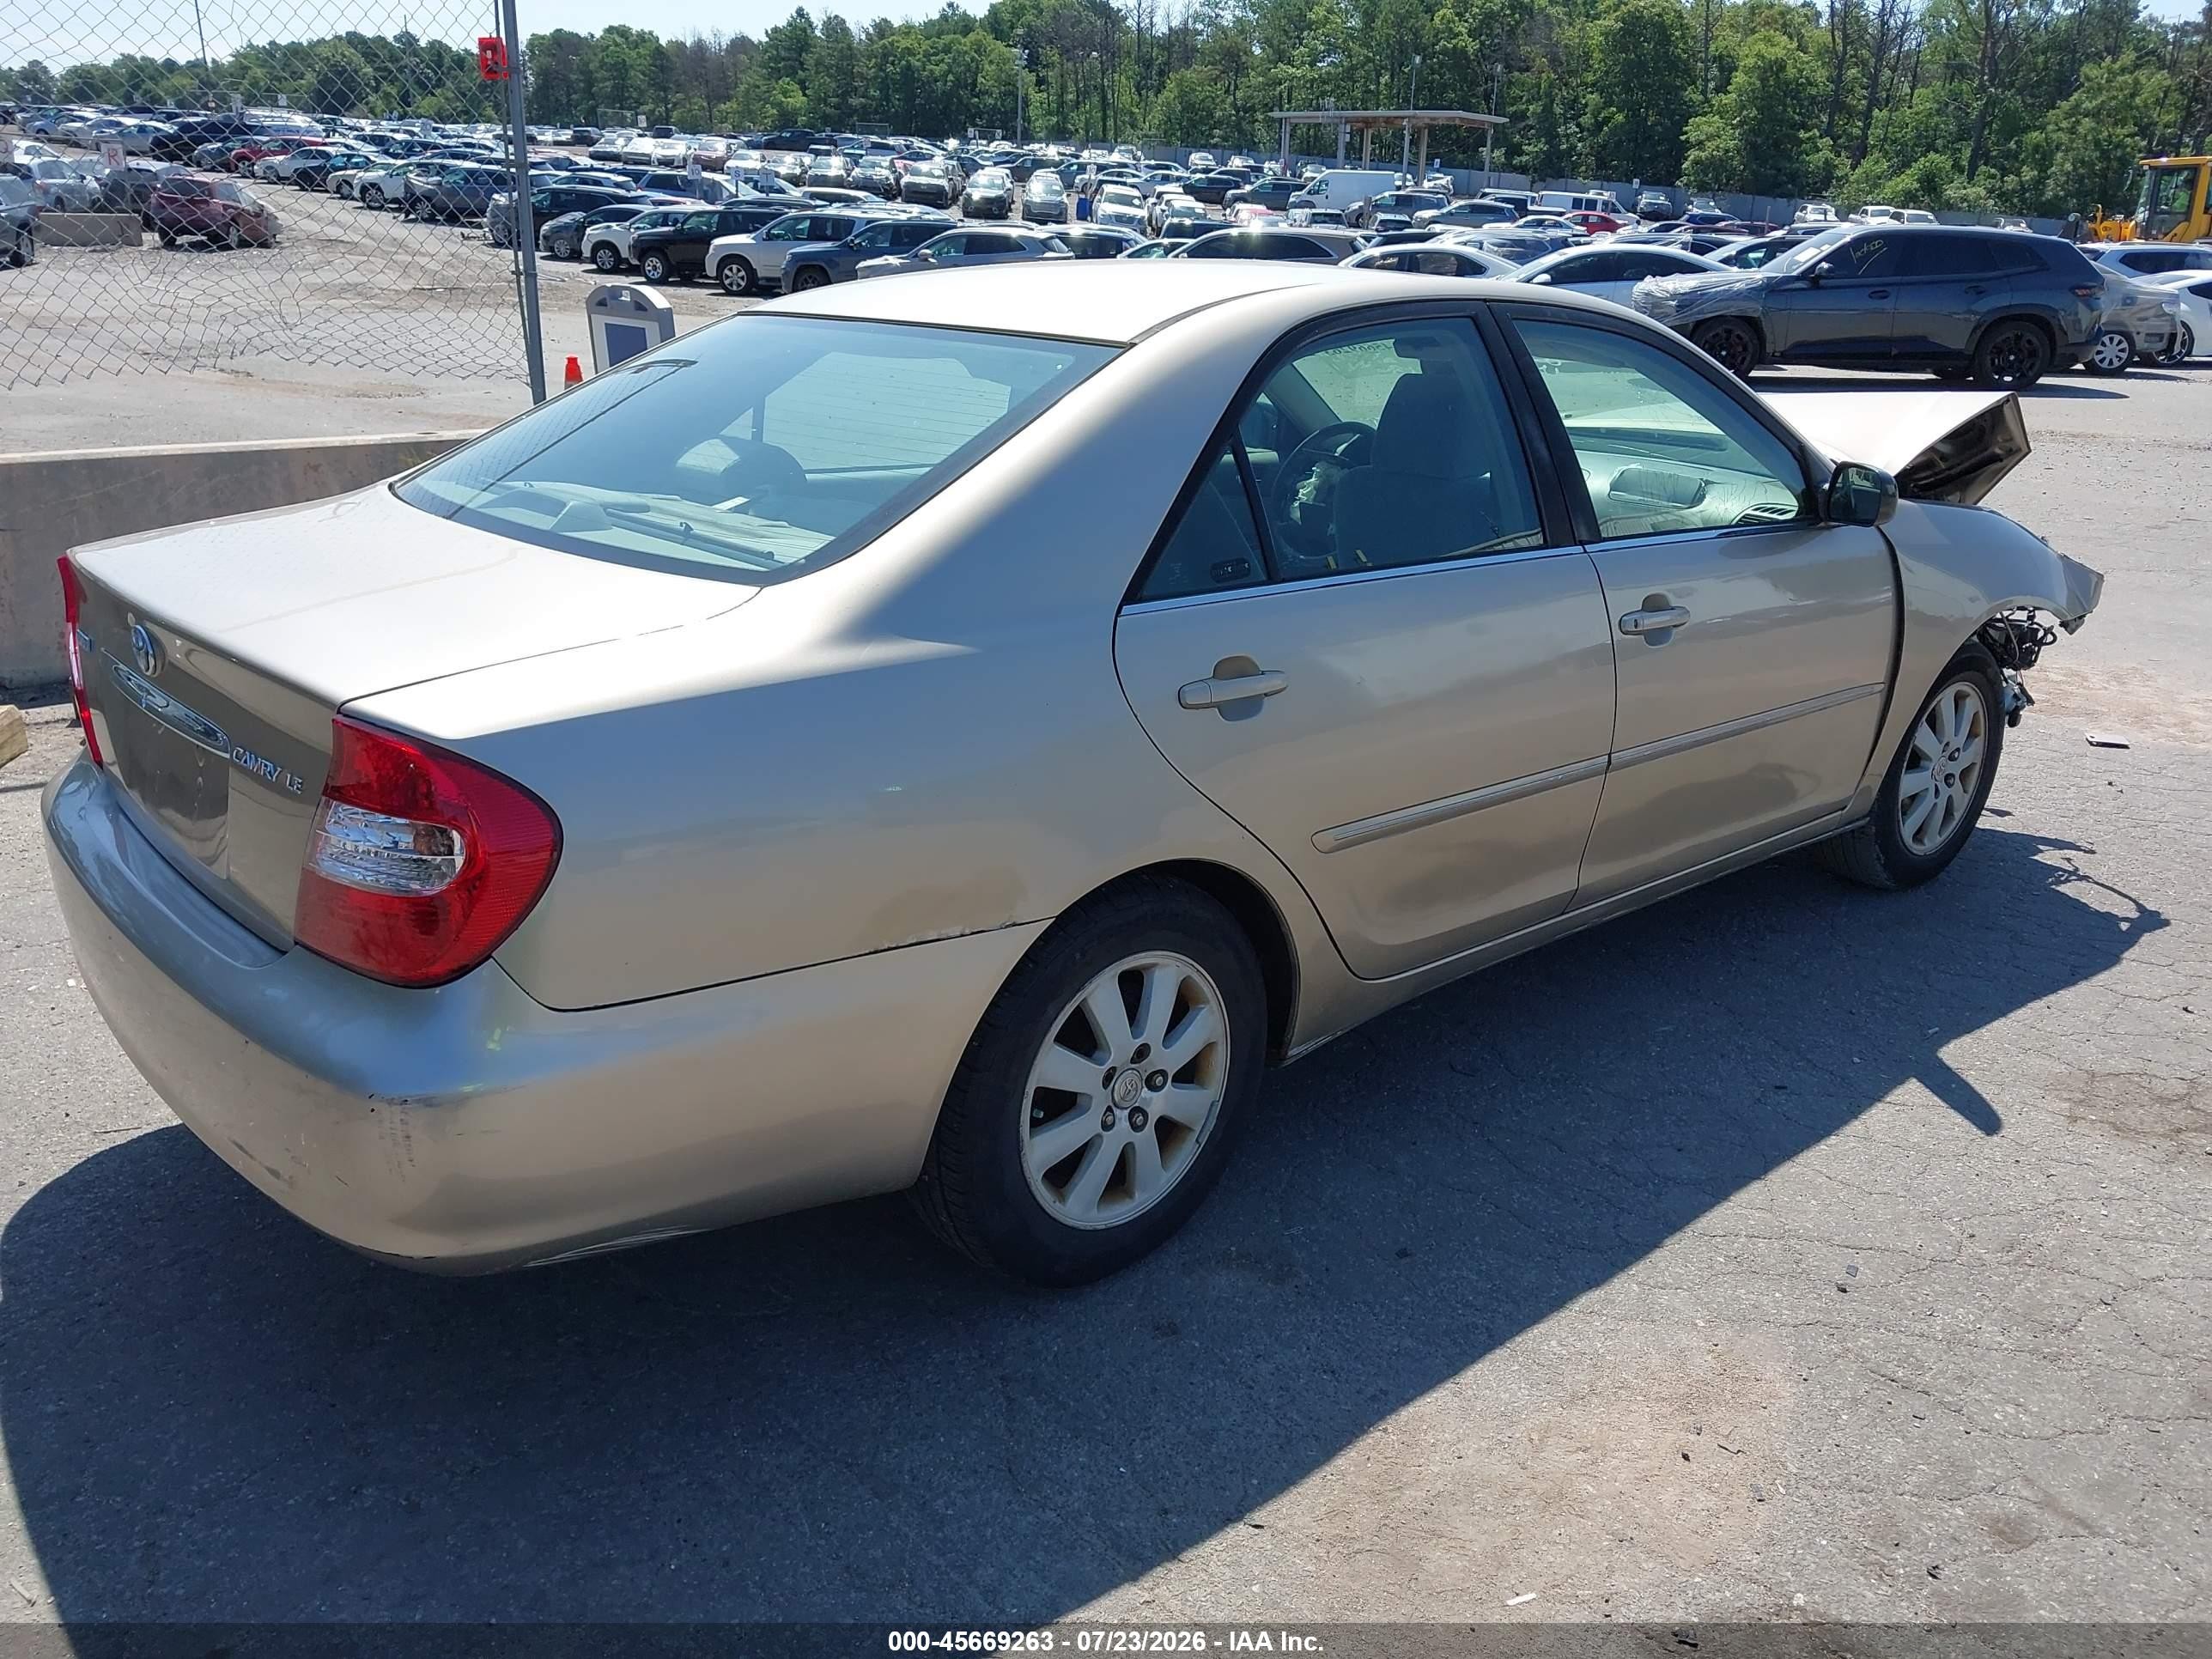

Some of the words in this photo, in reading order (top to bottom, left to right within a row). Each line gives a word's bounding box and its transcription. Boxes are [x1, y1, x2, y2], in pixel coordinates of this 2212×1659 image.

[108, 149, 119, 165] R
[691, 167, 699, 176] 10
[762, 172, 771, 182] T
[233, 747, 282, 782] CAMRY
[286, 774, 303, 794] LE
